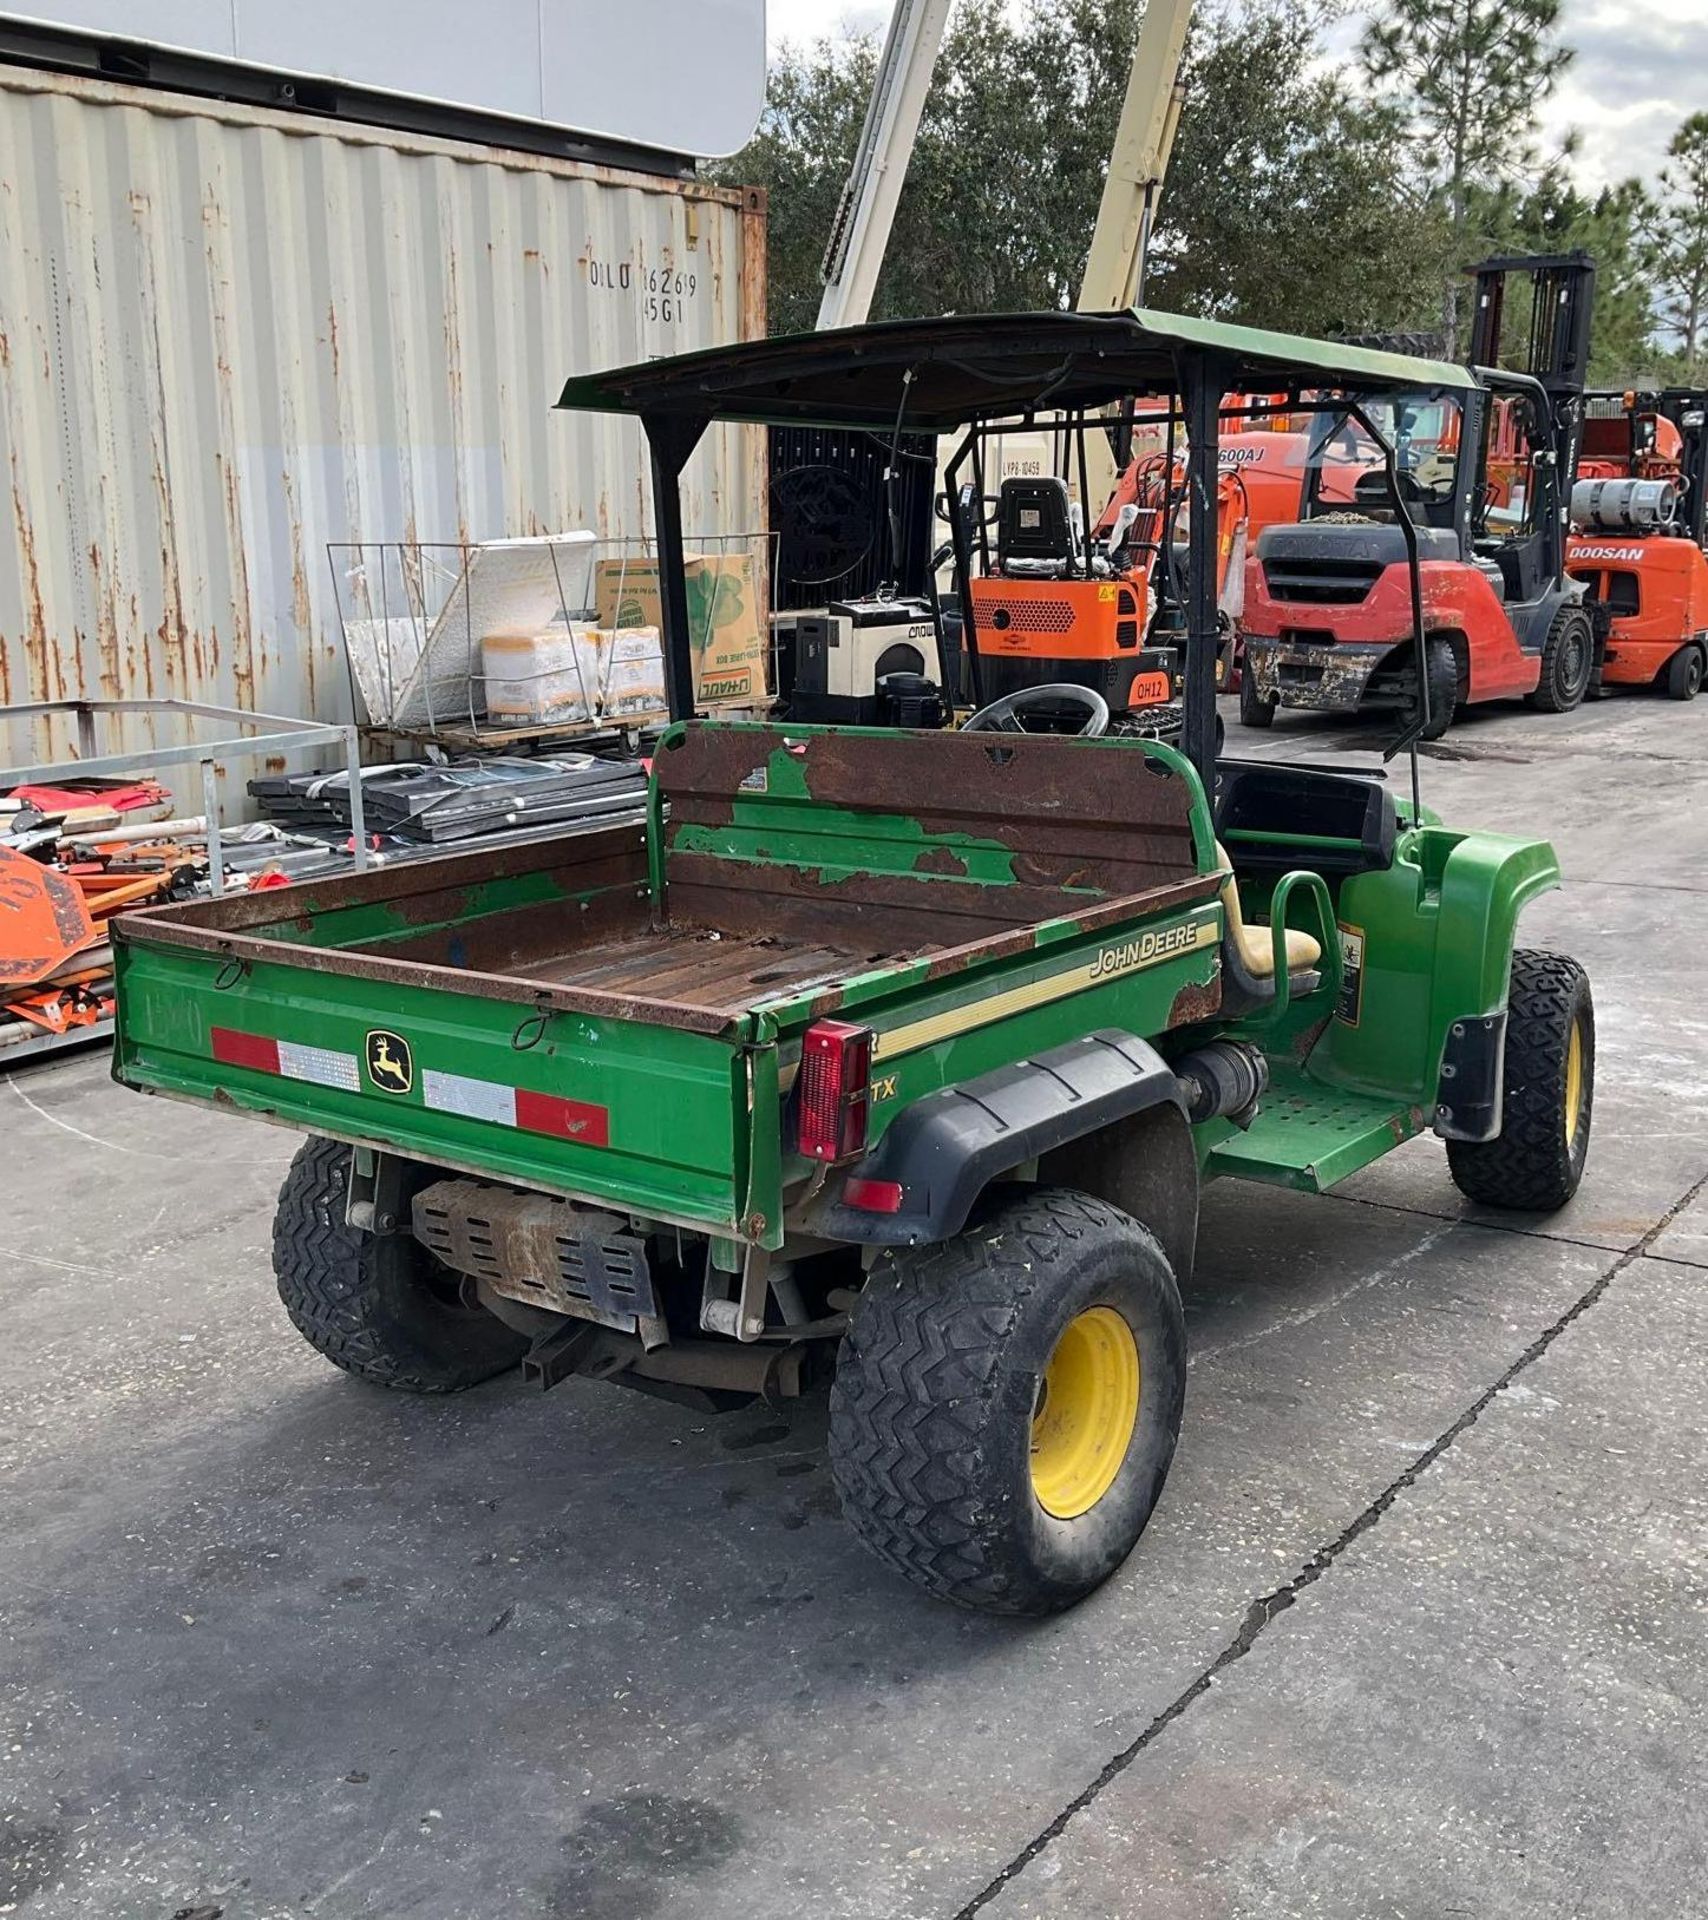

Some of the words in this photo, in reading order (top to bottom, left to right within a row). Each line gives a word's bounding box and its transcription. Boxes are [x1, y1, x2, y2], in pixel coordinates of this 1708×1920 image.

[644, 299, 682, 323] 45G1
[1218, 448, 1264, 462] 600AJ
[1569, 547, 1644, 560] DOOSAN
[908, 625, 934, 638] CROW
[702, 678, 748, 696] U-HAUL
[1089, 941, 1140, 978] JOHN
[1140, 922, 1197, 960] DEERE
[871, 1075, 897, 1102] TX
